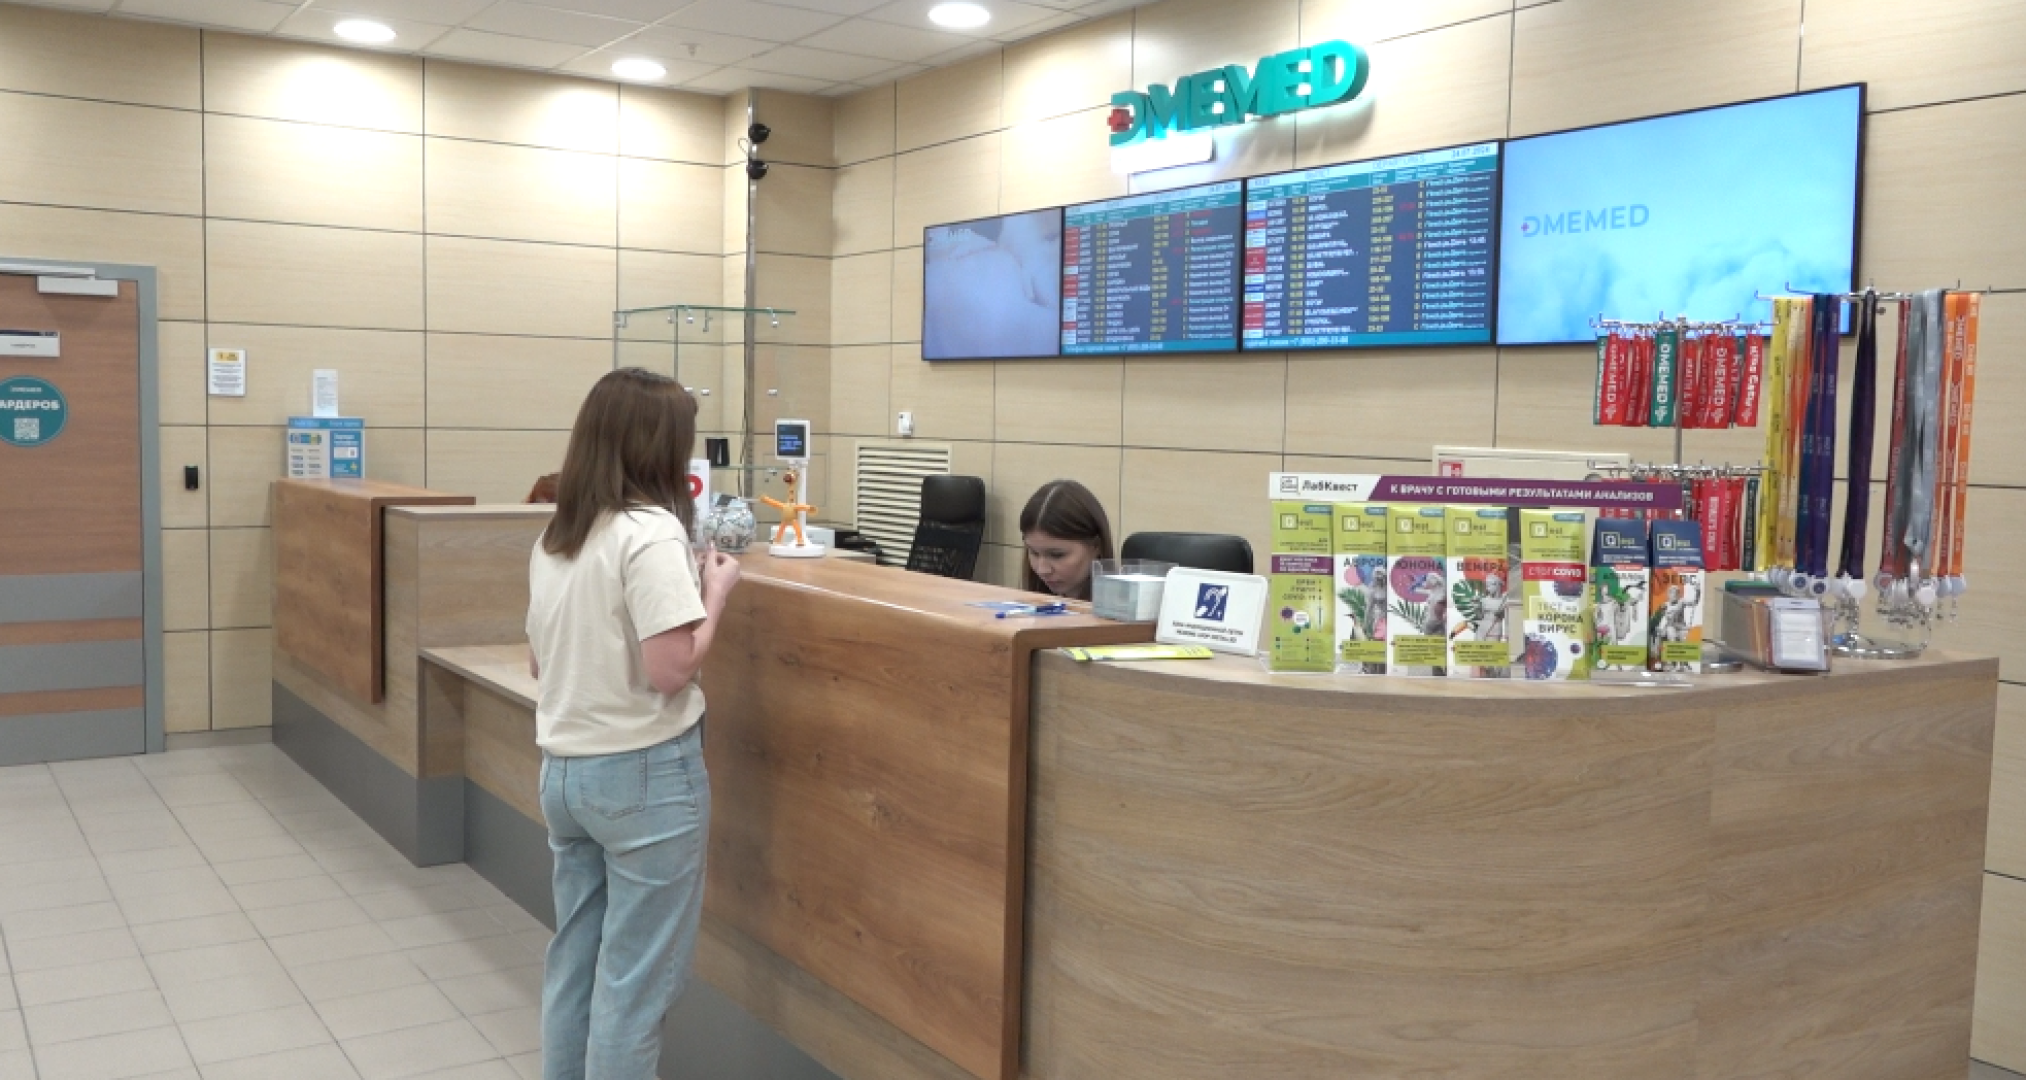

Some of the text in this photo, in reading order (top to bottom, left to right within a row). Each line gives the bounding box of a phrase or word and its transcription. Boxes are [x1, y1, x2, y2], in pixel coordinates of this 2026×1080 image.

[1108, 40, 1369, 147] DMEMED
[1521, 204, 1650, 238] DMEMED
[1656, 343, 1672, 403] DMEMED
[1714, 347, 1728, 406] DMEMED
[1302, 479, 1359, 492] ЛабКвест
[1390, 484, 1654, 502] К ВРАЧУ С ГОТОВЫМИ РЕЗУЛЬТАТАМИ АНАЛИЗОВ
[1344, 557, 1387, 568] АВРОР
[1537, 601, 1563, 611] ТЕСТ
[1537, 613, 1584, 623] КОРОНА
[1538, 624, 1578, 634] ВИРУС
